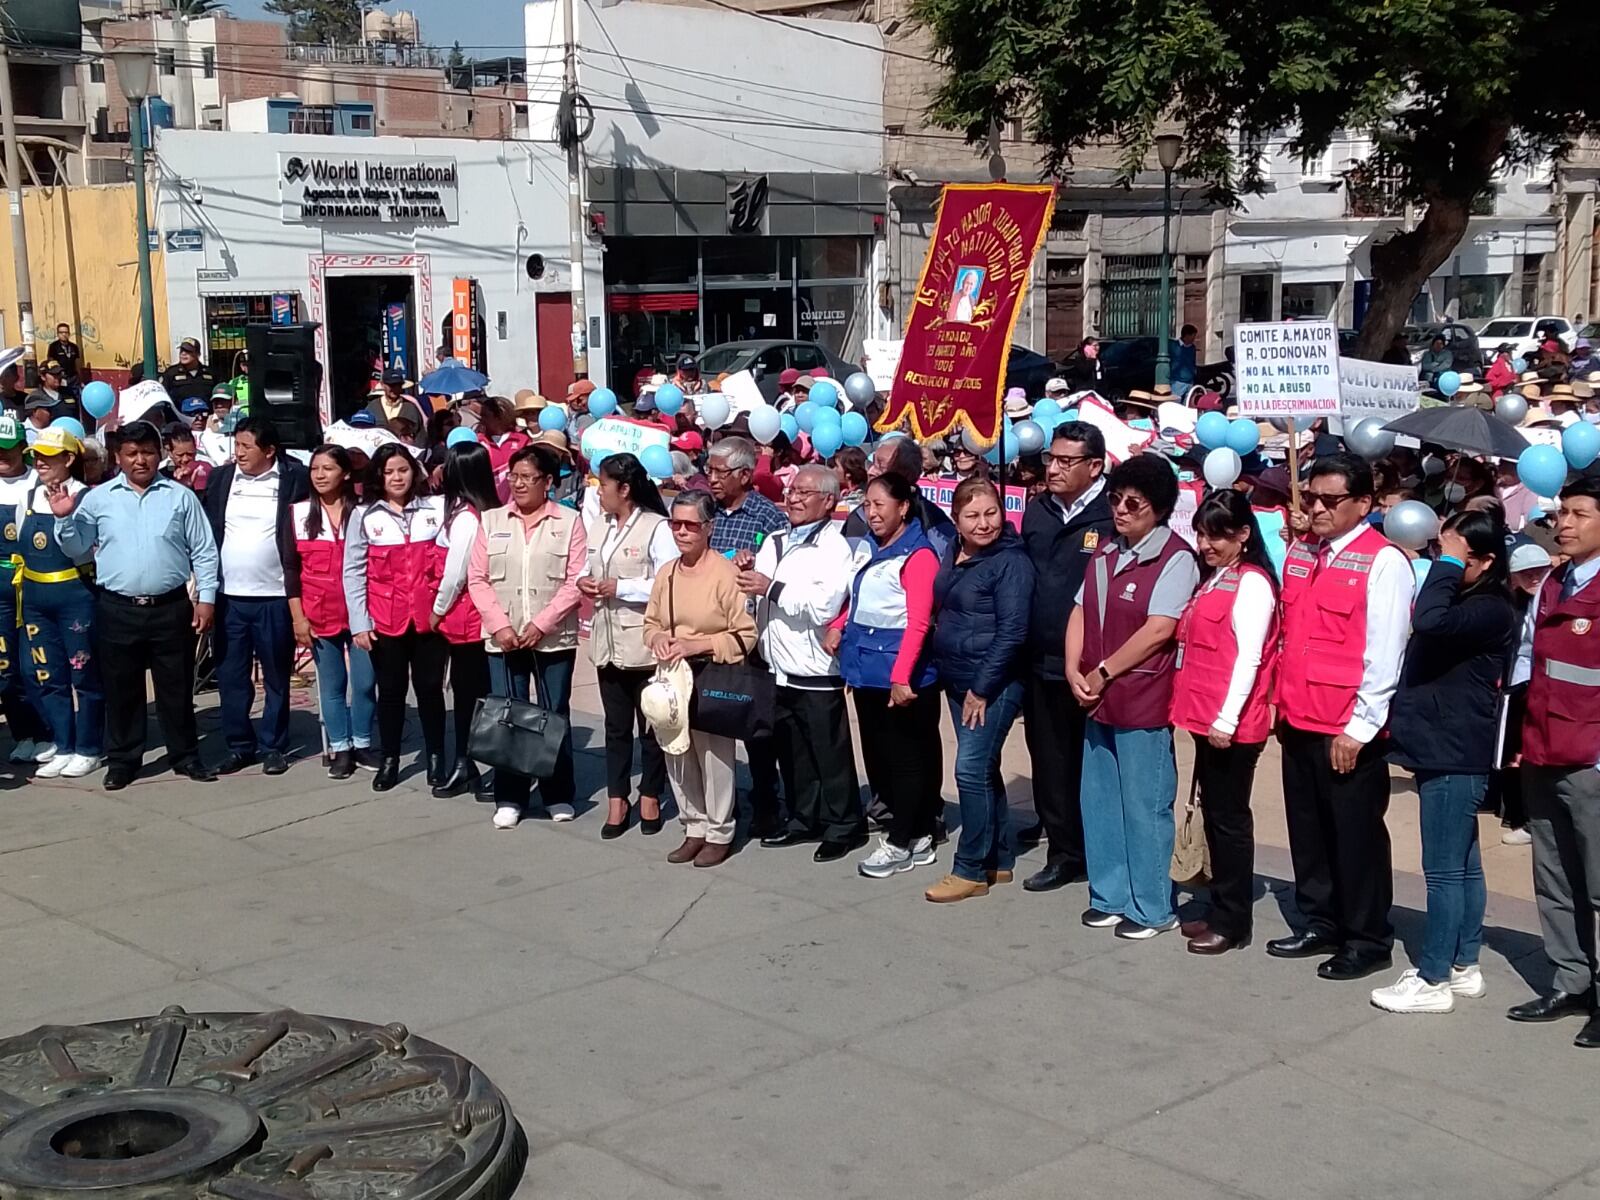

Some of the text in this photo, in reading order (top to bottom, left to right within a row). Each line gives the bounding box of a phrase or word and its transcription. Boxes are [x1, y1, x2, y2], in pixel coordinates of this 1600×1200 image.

[311, 159, 455, 182] World International
[303, 186, 440, 202] Agencia de Viajes y Turismo
[301, 205, 446, 218] INFORMACION TURISTICA
[992, 206, 1021, 243] JUAN
[800, 310, 846, 321] COMPLICES
[381, 309, 390, 354] VIAJES
[1240, 328, 1278, 343] COMITE
[1246, 345, 1327, 361] R. O'DONOVAN
[1261, 366, 1274, 377] AL
[1277, 364, 1330, 376] MALTRATO
[1262, 382, 1276, 394] AL
[1279, 382, 1311, 394] ABUSO
[1243, 400, 1252, 411] NO
[1254, 399, 1260, 411] A
[1261, 399, 1271, 411] LA
